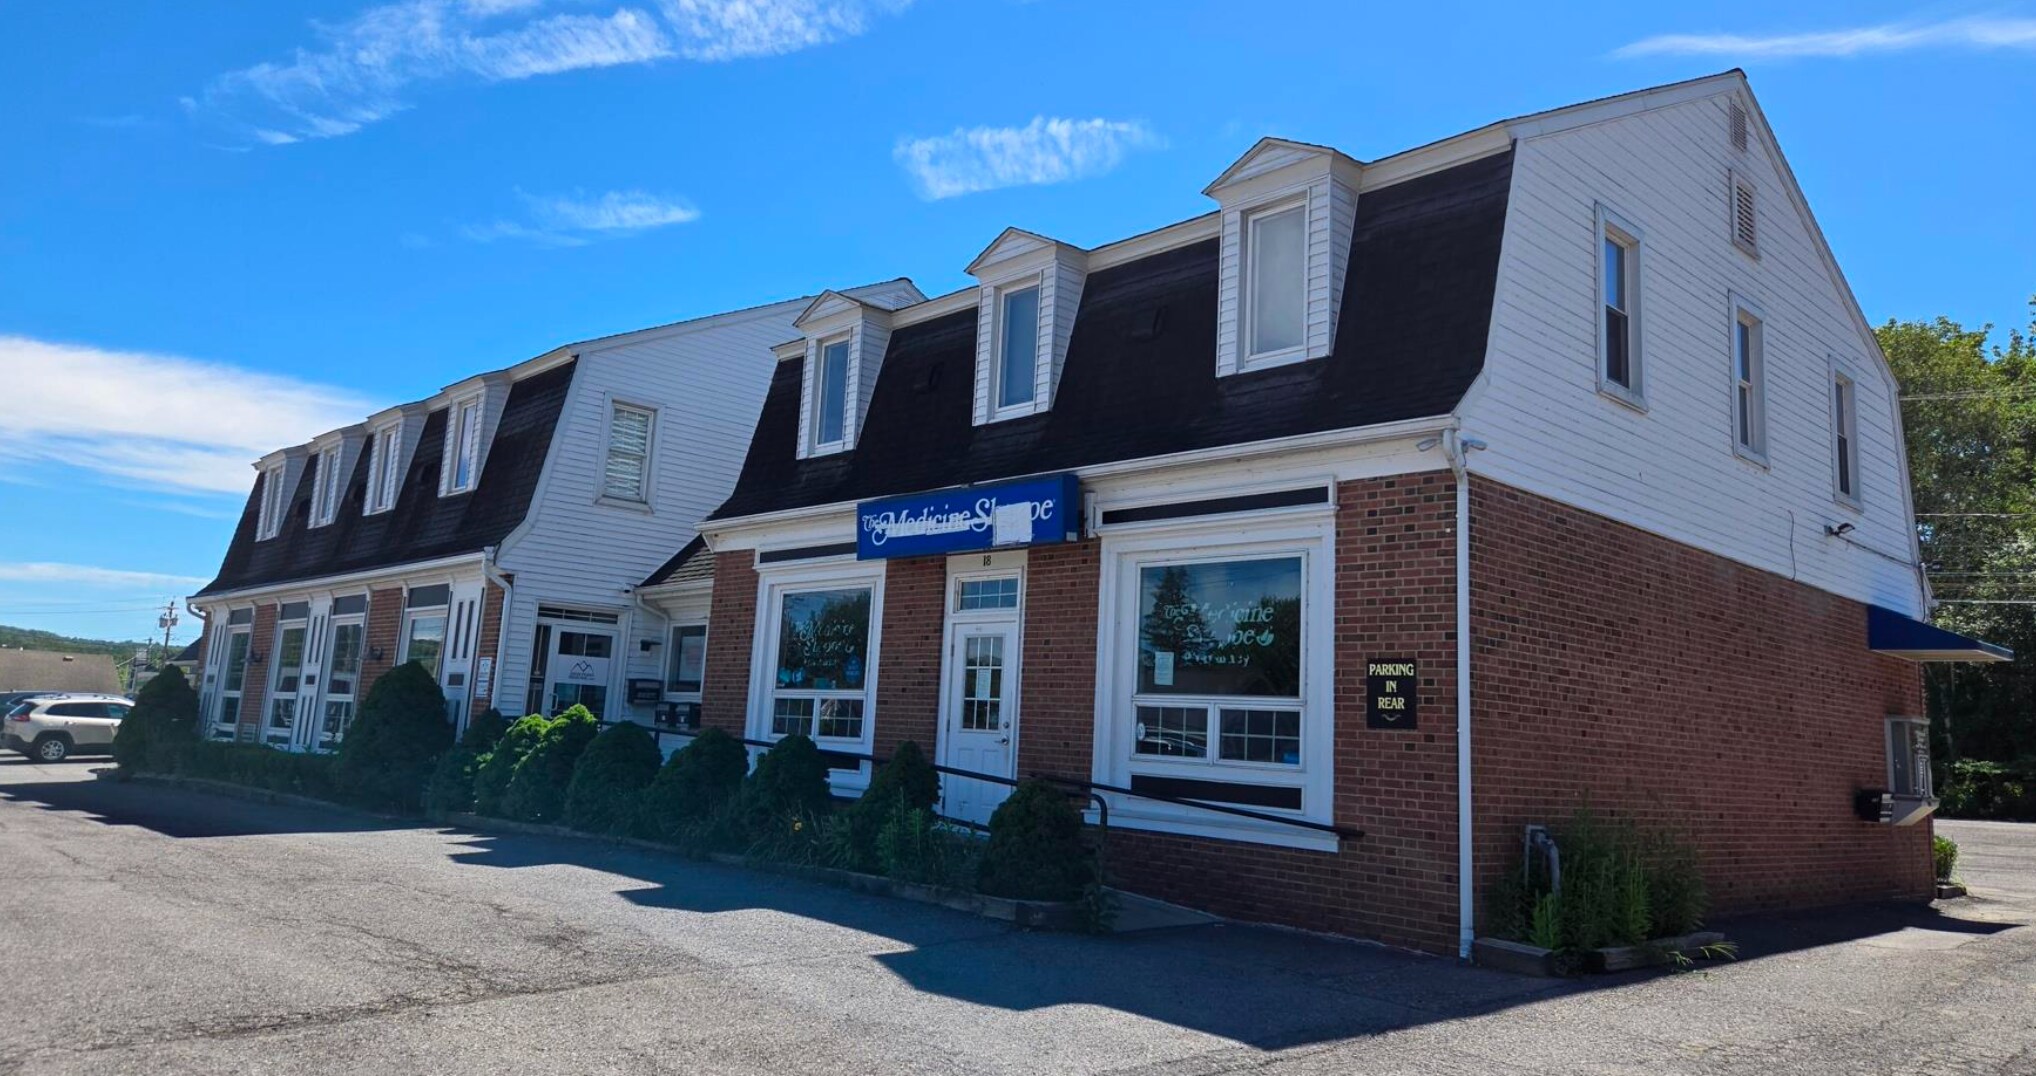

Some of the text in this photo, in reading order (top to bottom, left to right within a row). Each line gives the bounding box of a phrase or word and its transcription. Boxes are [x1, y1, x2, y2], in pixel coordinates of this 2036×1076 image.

[862, 497, 1054, 546] The Medicine Spe
[983, 555, 992, 567] 18
[1369, 663, 1415, 677] PARKING
[1385, 680, 1398, 693] IN
[1377, 697, 1406, 710] REAR
